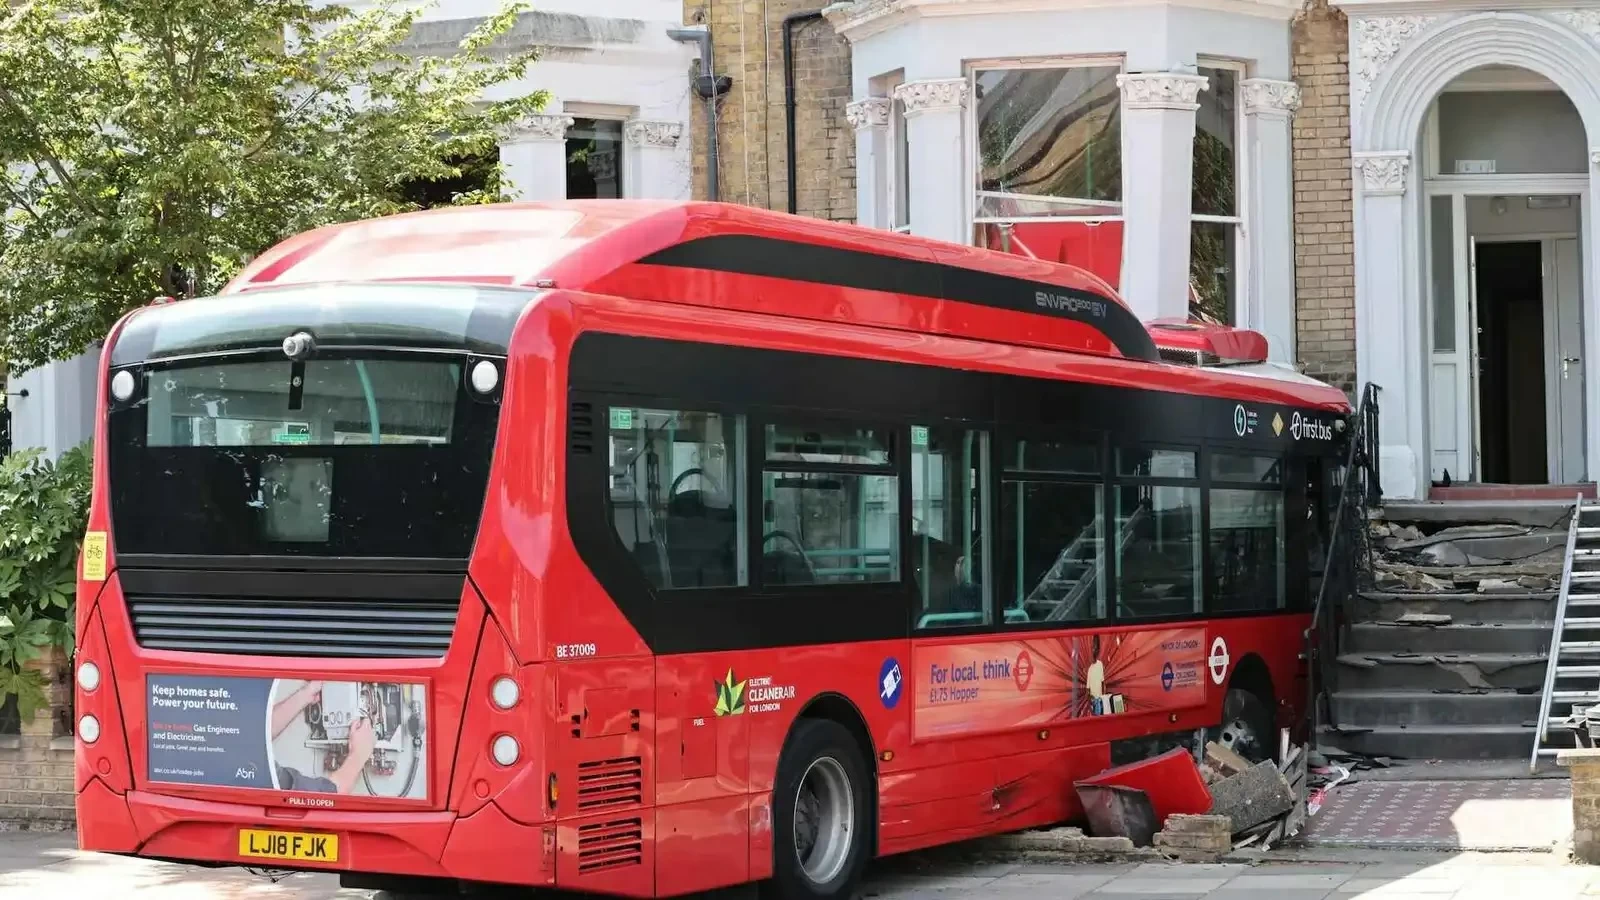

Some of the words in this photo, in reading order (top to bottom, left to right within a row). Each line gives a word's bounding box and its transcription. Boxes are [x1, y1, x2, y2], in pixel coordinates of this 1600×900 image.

[1303, 418, 1318, 439] first
[1319, 419, 1332, 441] bus
[556, 645, 568, 657] BE
[569, 643, 596, 656] 37009
[930, 664, 948, 684] For
[951, 661, 979, 682] local.
[983, 659, 1010, 680] think
[152, 684, 175, 697] Keep
[177, 686, 207, 697] homes
[209, 688, 231, 698] safe.
[749, 685, 796, 702] CLEANERAIR
[950, 686, 979, 703] Hopper
[152, 697, 181, 707] Power
[183, 700, 204, 710] your
[206, 699, 238, 710] future.
[749, 704, 759, 713] FOR
[759, 702, 780, 712] LONDON
[193, 724, 206, 733] Gas
[207, 725, 240, 735] Engineers
[693, 719, 704, 727] FUEL
[153, 732, 165, 740] and
[167, 732, 206, 742] Electricians.
[235, 767, 255, 779] Abri
[289, 797, 306, 806] PULL
[316, 799, 334, 807] OPEN
[249, 834, 287, 855] LJ18
[293, 836, 327, 857] FJK
